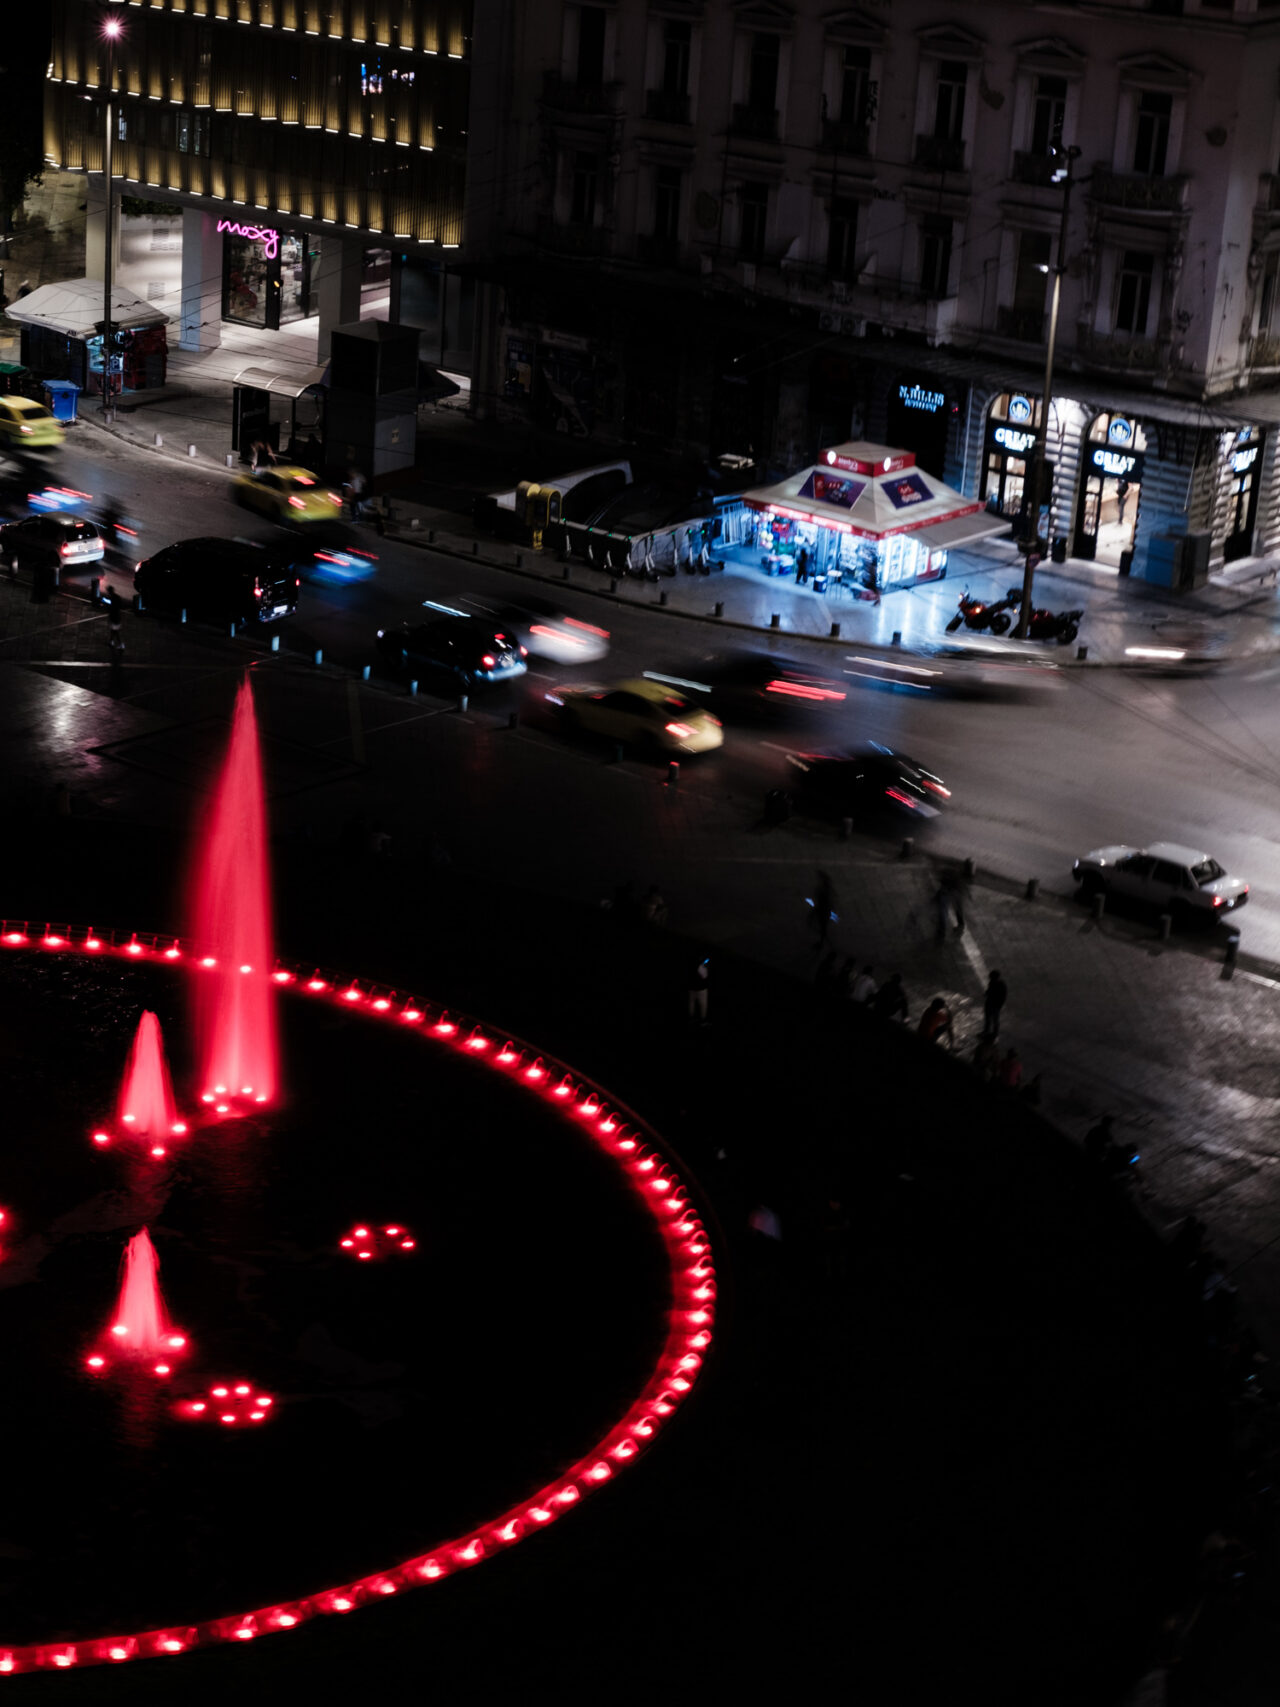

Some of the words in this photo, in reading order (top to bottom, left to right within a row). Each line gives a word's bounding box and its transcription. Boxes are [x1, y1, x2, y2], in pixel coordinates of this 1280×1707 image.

[216, 219, 280, 260] moxy
[995, 427, 1036, 450] GREAT
[1093, 449, 1136, 473] GREAT
